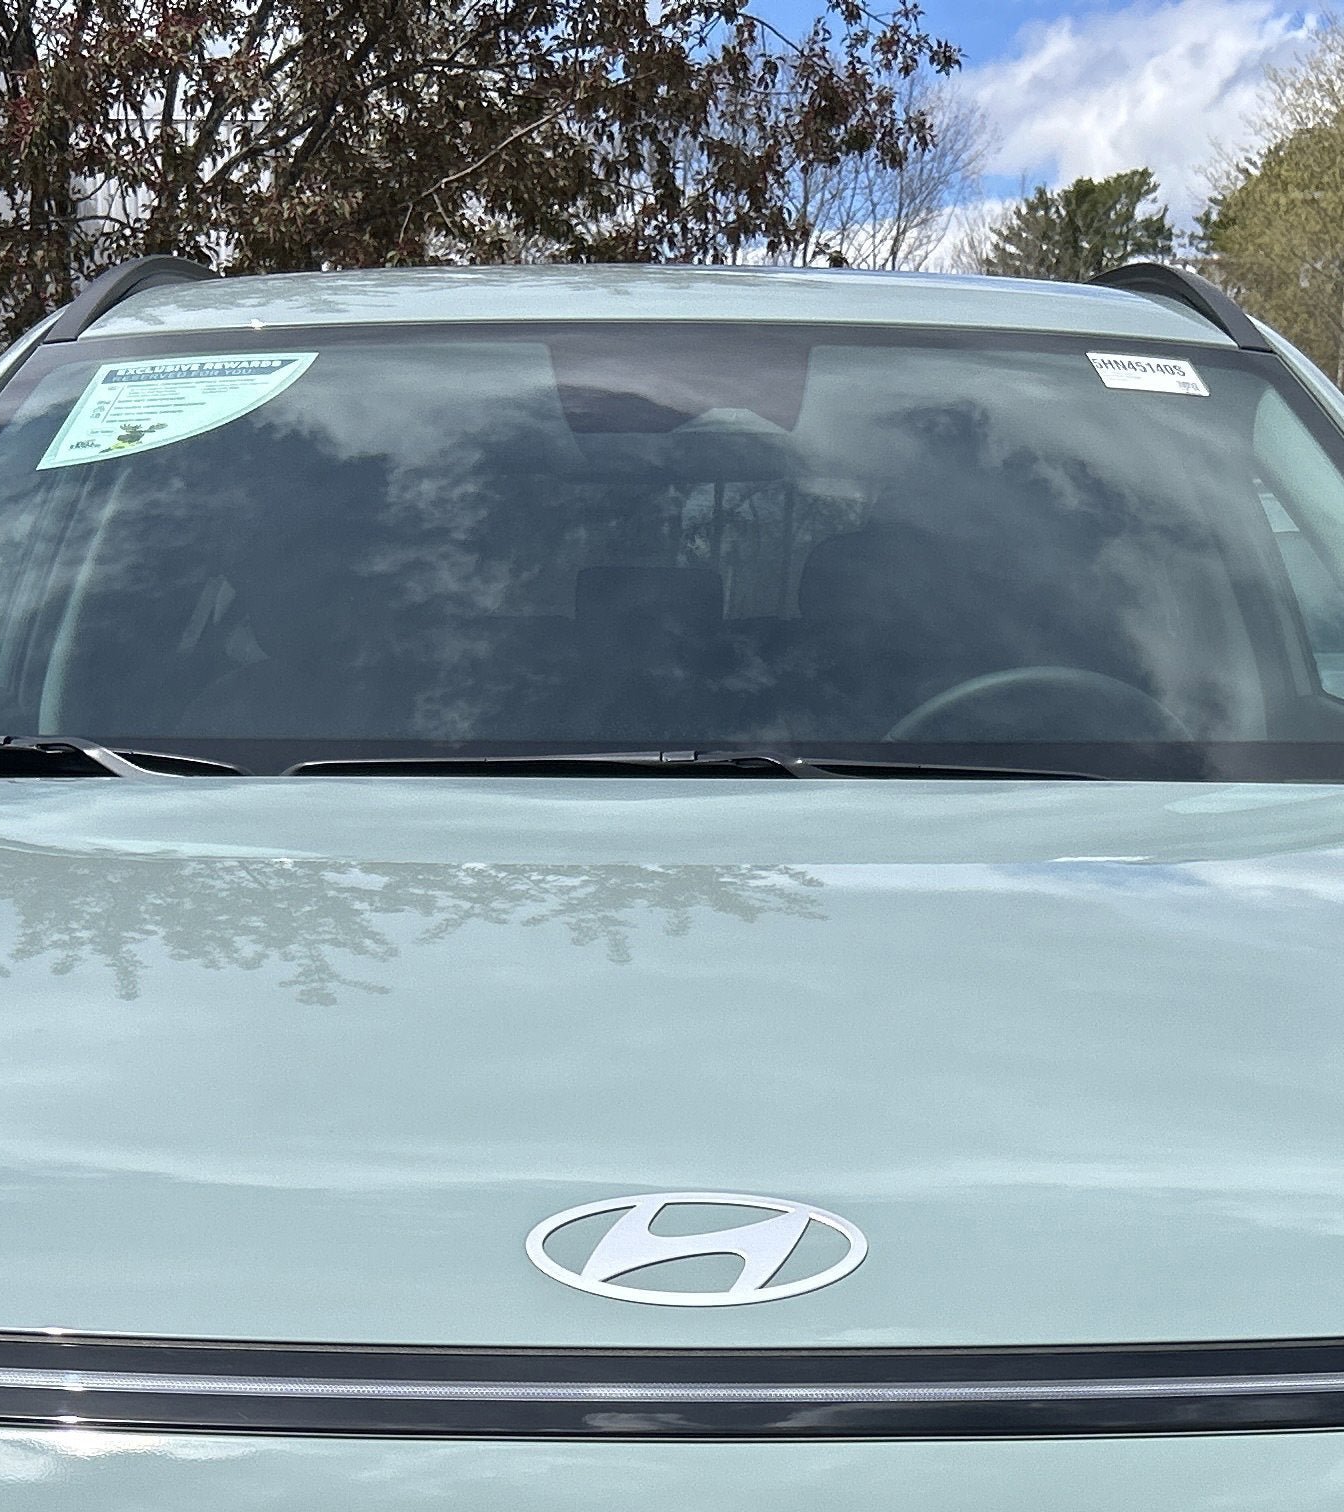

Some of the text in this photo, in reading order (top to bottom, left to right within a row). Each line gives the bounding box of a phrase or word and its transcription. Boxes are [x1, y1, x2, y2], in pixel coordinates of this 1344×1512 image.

[116, 360, 282, 376] EXCLUSIVE REWARDS
[112, 371, 187, 382] RESERVED
